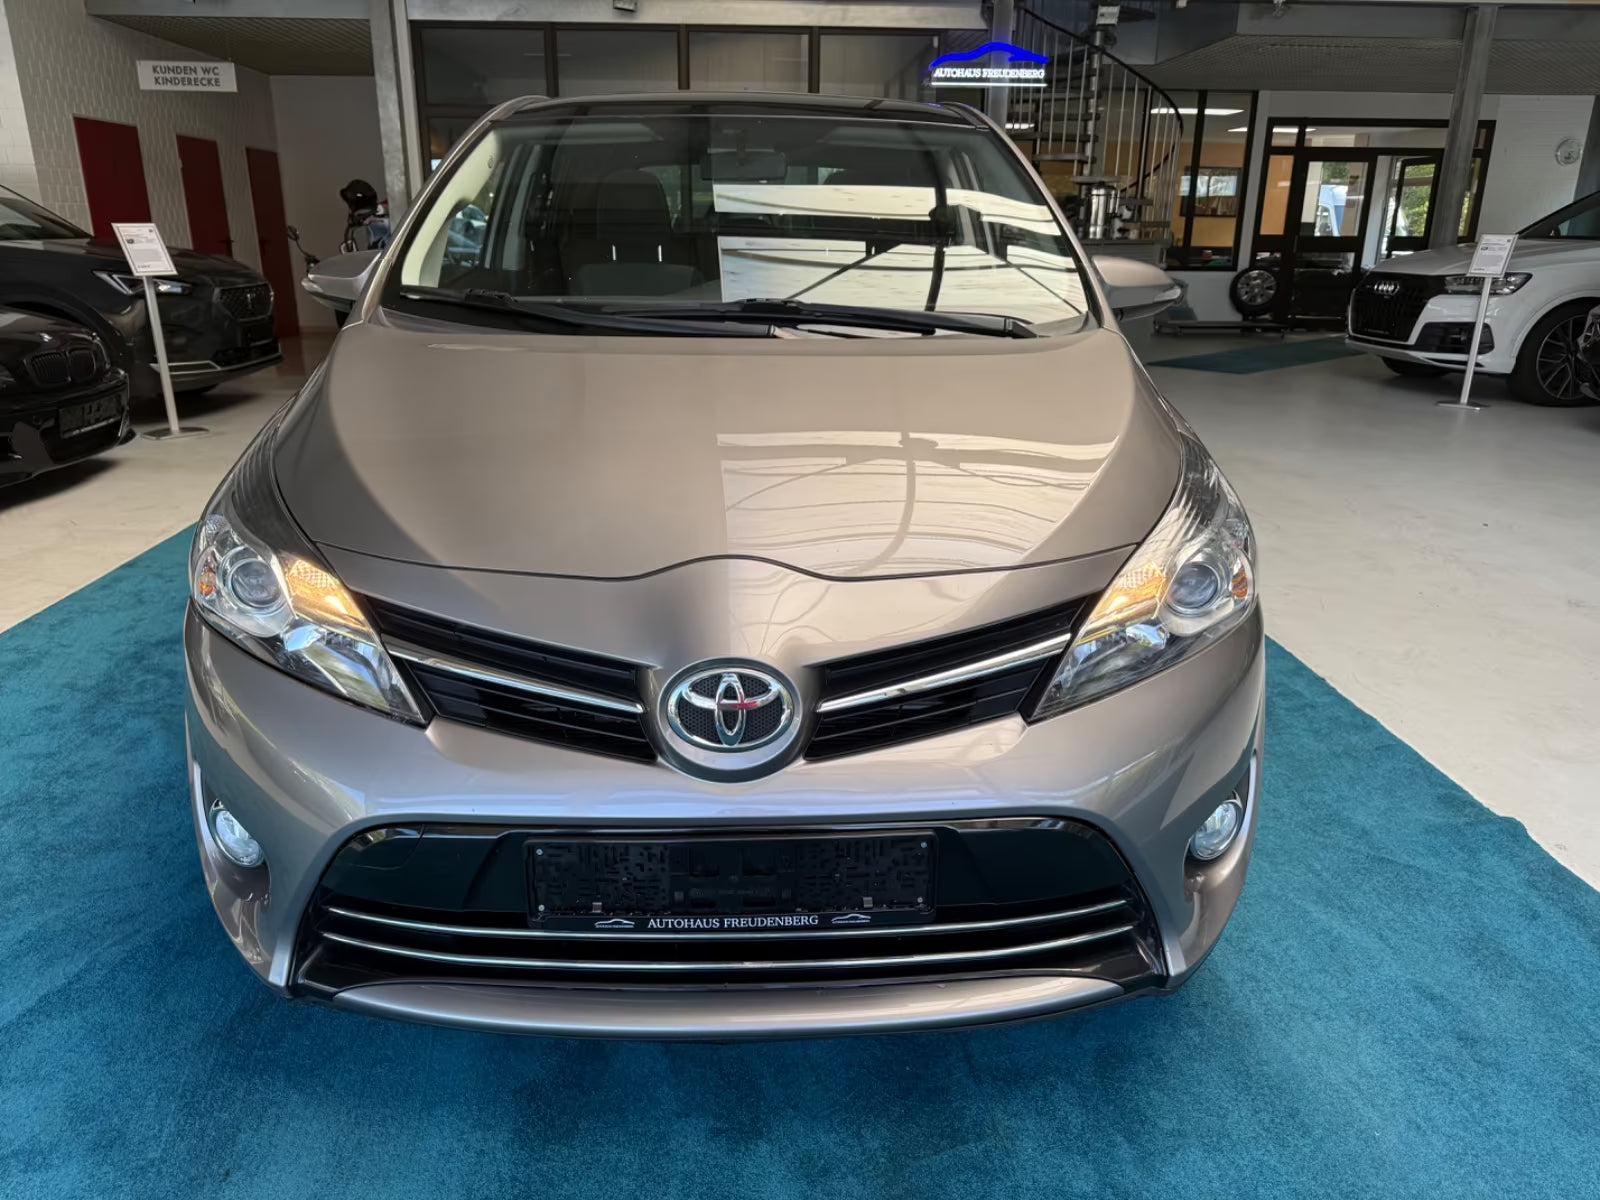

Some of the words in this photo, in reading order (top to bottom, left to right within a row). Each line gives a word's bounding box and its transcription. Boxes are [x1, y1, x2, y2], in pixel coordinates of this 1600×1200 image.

[152, 65, 198, 75] KUNDEN
[201, 66, 220, 76] WC
[933, 68, 981, 78] AUTOHAUS
[982, 68, 1045, 79] FREUDENBERG
[154, 76, 221, 87] KINDERECKE
[647, 918, 720, 929] AUTOHAUS
[723, 915, 819, 929] FREUDENBERG
